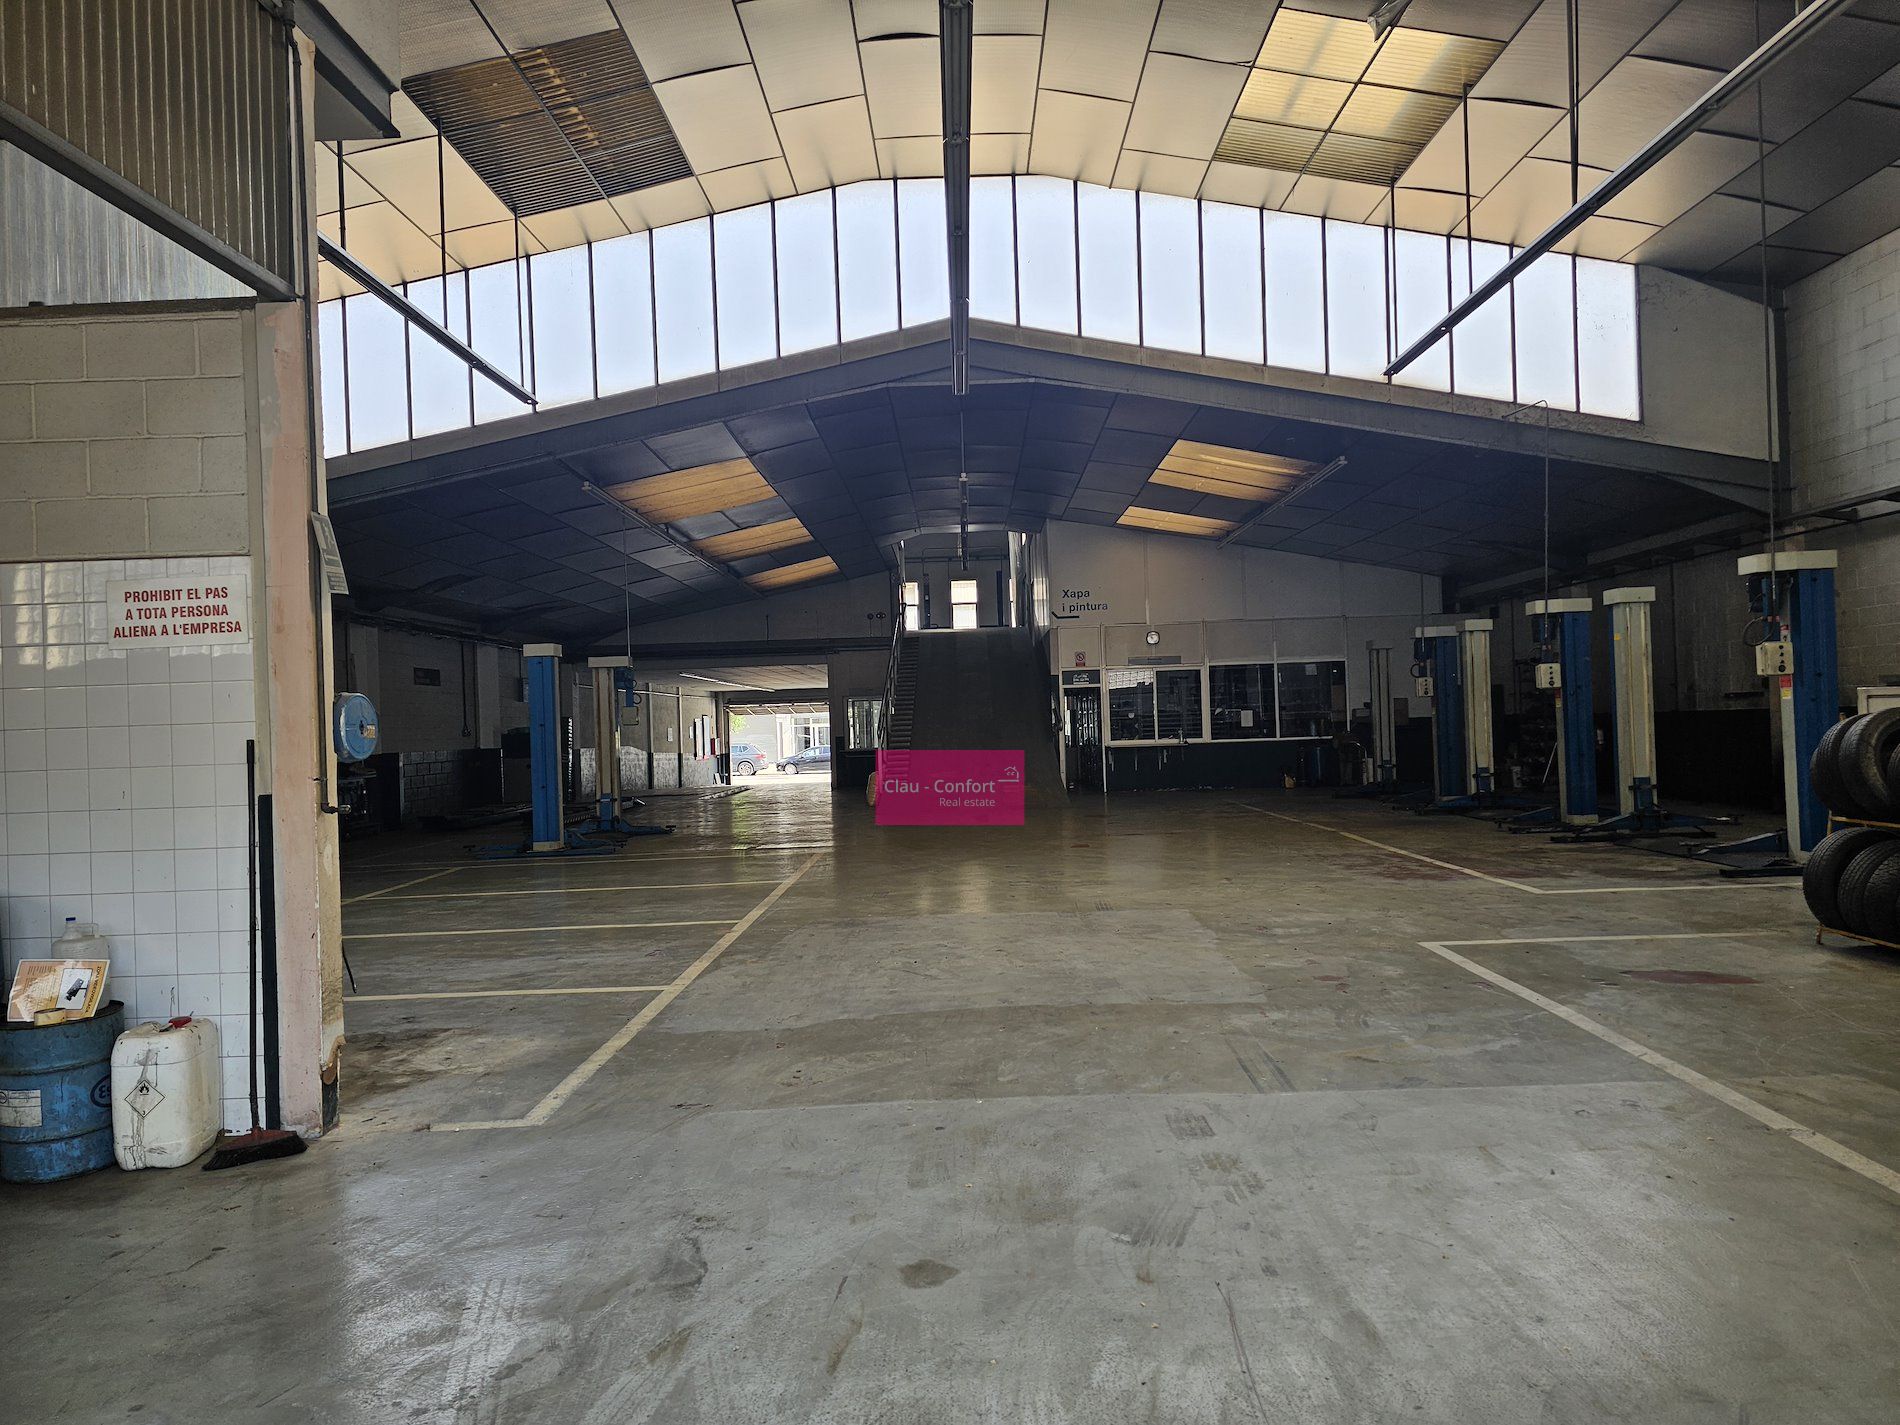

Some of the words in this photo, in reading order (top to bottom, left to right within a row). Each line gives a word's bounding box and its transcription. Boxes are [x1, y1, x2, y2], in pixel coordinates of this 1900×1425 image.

[124, 589, 183, 603] PROHIBIT
[187, 588, 202, 601] EL
[205, 586, 229, 599] PAS
[1062, 589, 1090, 599] Xapa
[125, 608, 134, 621] A
[136, 607, 167, 620] TOTA
[171, 604, 229, 618] PERSONA
[1069, 602, 1108, 613] pintura
[113, 625, 157, 639] ALIENA
[161, 624, 169, 636] A
[173, 621, 242, 636] L'EMPRESA
